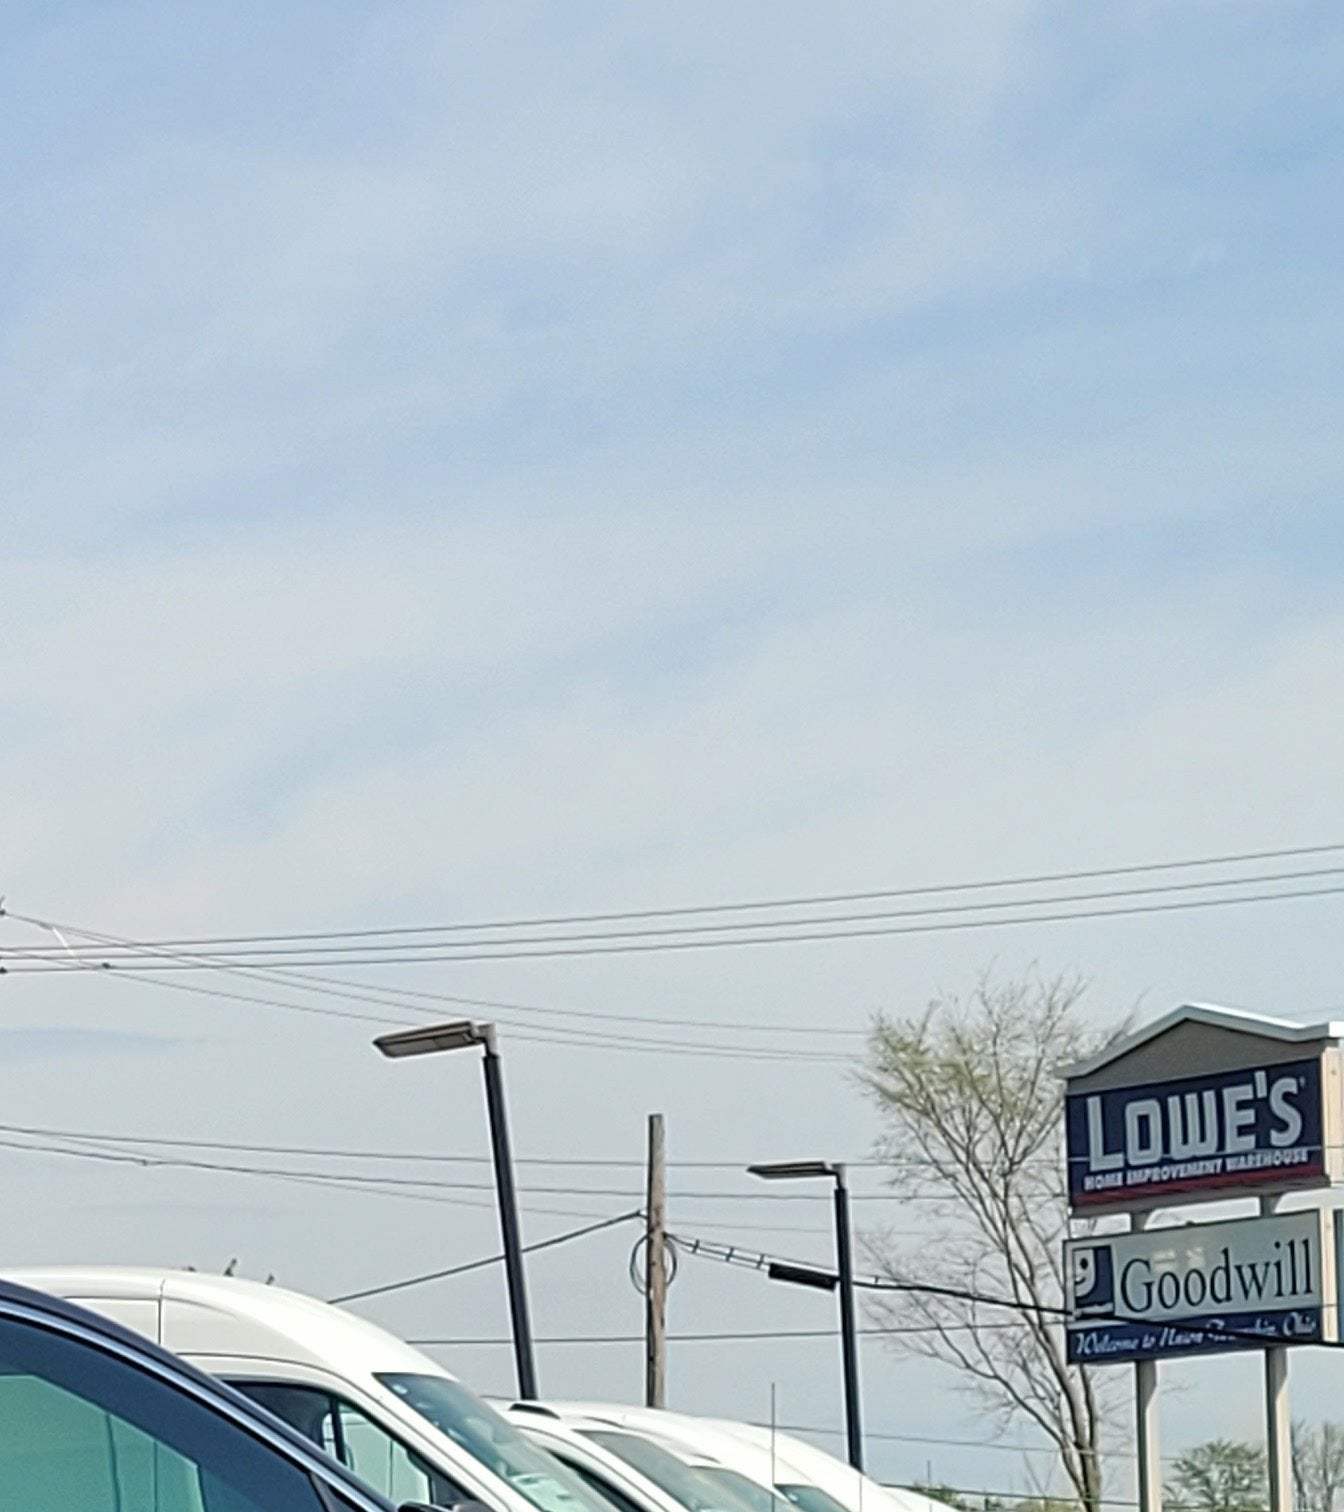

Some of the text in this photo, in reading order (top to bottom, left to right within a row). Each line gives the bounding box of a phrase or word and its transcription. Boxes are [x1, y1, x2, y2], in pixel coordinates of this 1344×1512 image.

[1086, 1070, 1303, 1172] LOWE'S
[1083, 1148, 1309, 1192] HOME IMPROVEMENT WAREHOUSE
[1120, 1237, 1313, 1314] Goodwill
